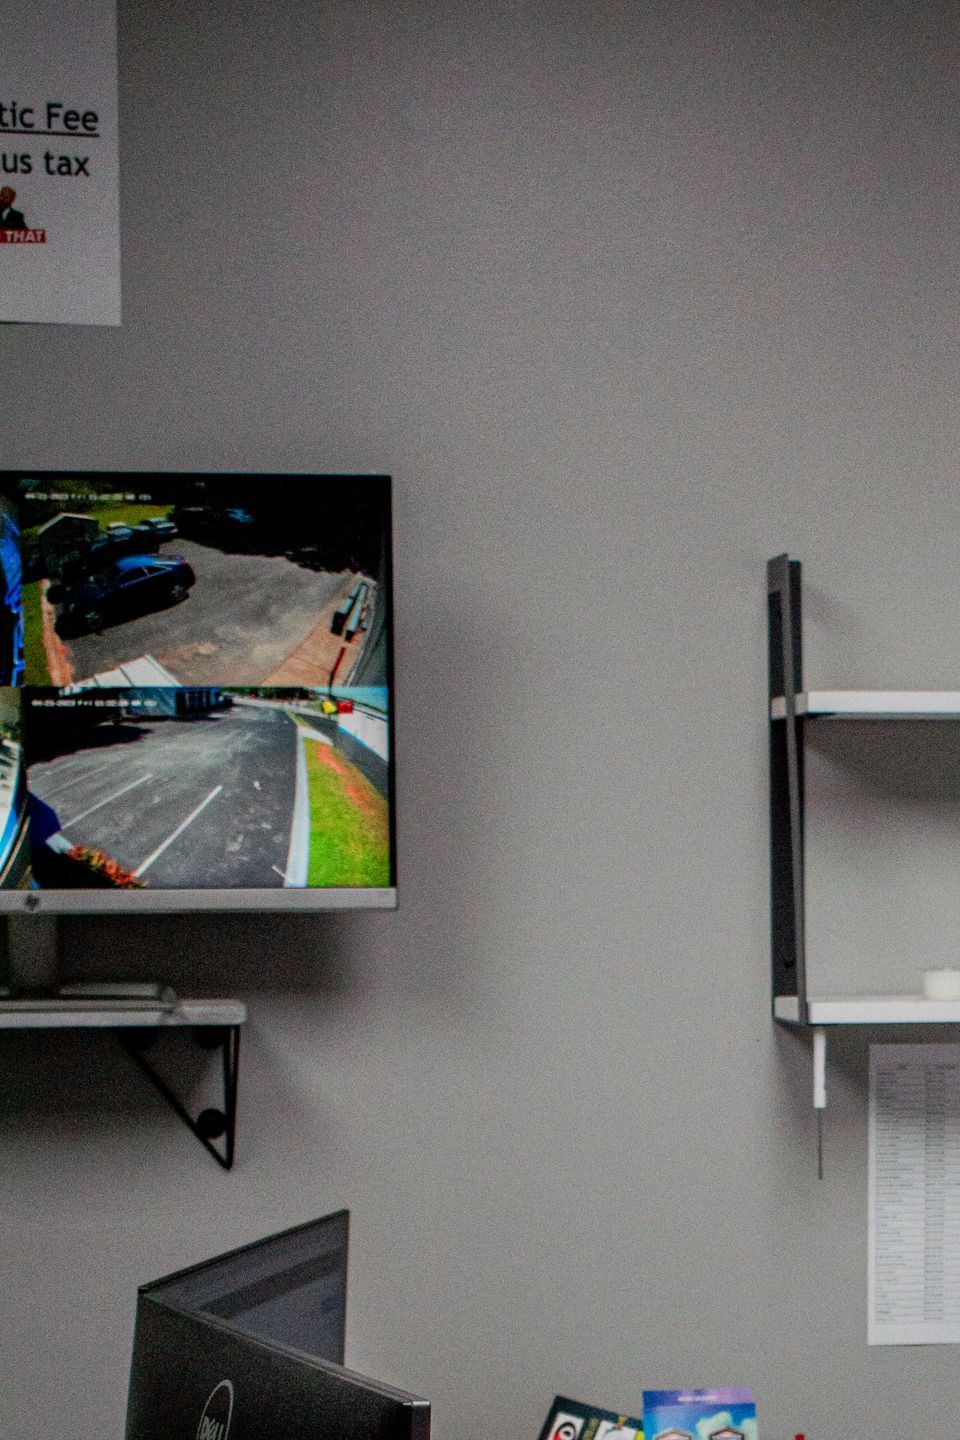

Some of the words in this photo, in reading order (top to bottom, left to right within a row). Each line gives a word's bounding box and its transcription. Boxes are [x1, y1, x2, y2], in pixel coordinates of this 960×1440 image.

[46, 102, 99, 131] Fee
[44, 151, 90, 177] tax
[5, 230, 44, 242] THAT
